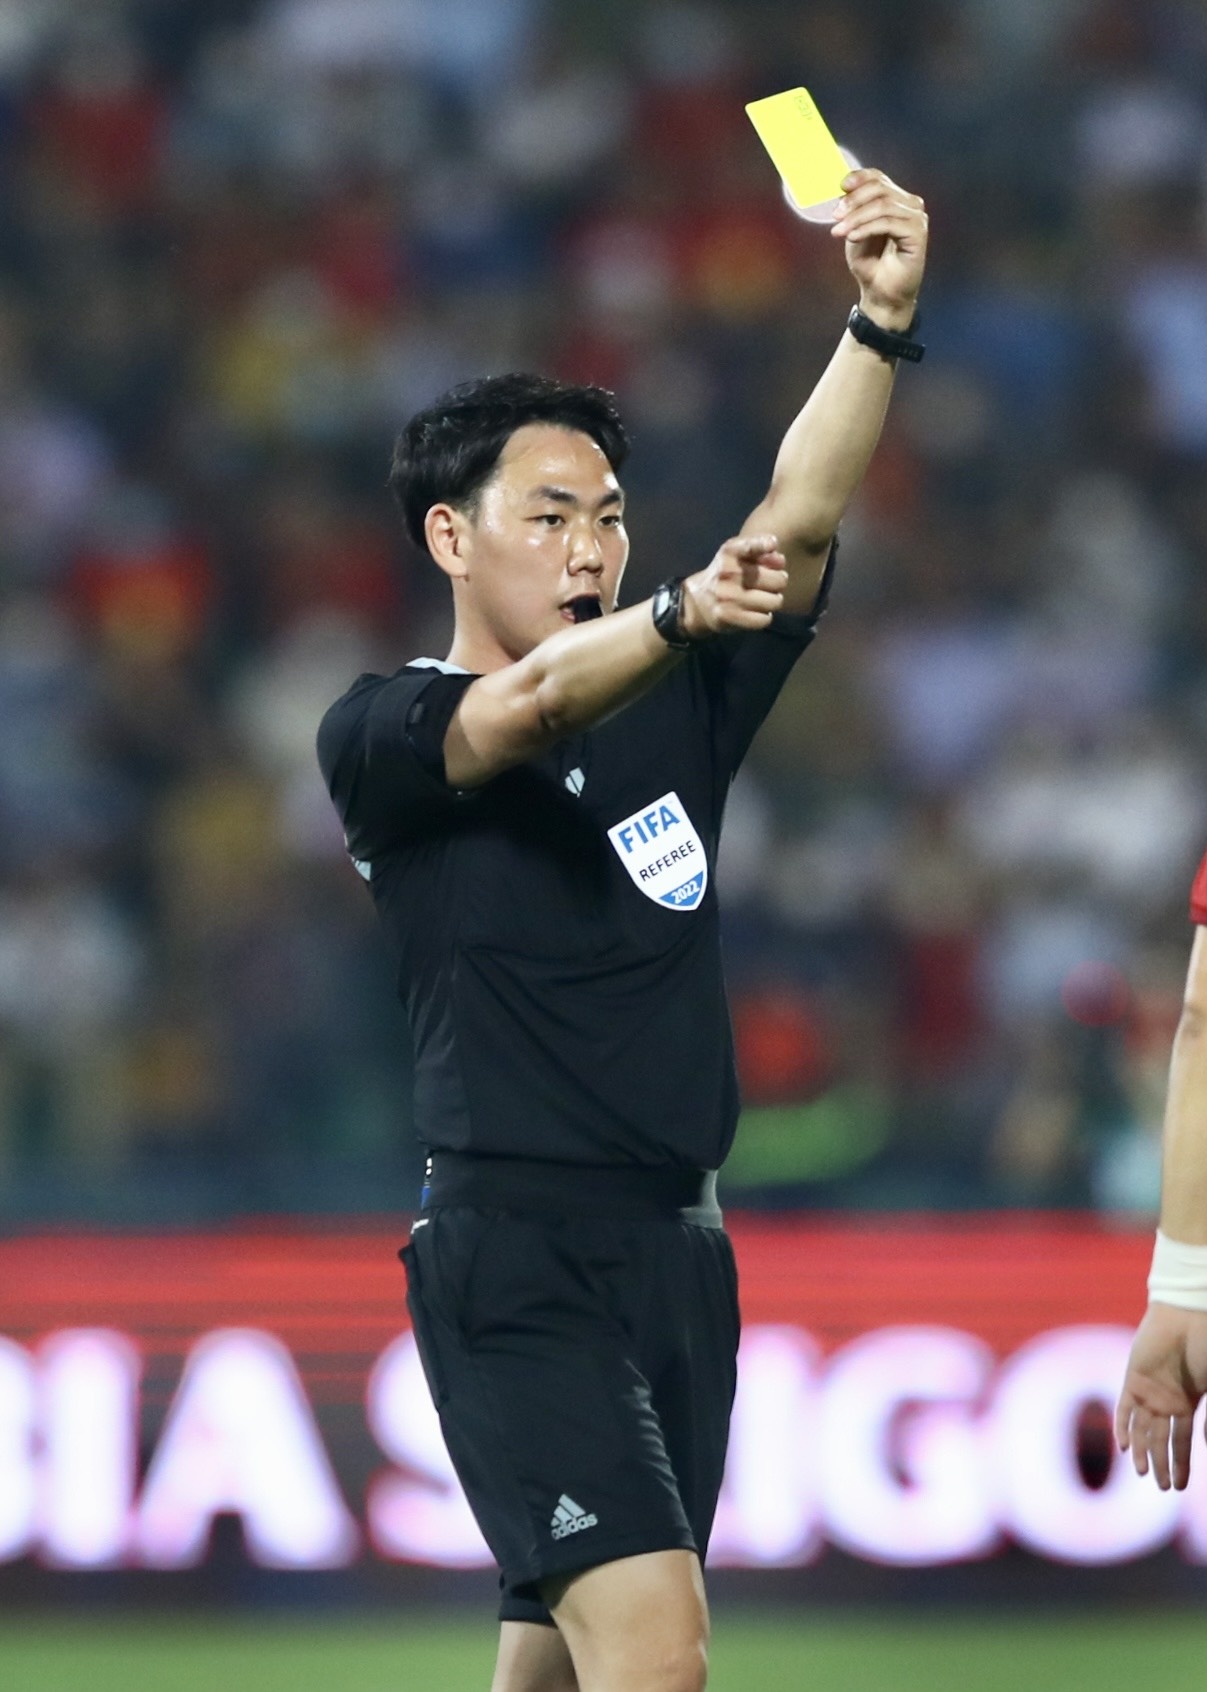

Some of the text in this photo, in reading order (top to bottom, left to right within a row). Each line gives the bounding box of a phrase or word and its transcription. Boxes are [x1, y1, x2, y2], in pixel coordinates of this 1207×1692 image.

[618, 805, 680, 853] FIFA
[639, 840, 696, 881] REFEREE
[671, 881, 700, 904] 2022
[0, 1327, 357, 1570] IA
[551, 1513, 598, 1540] adidas
